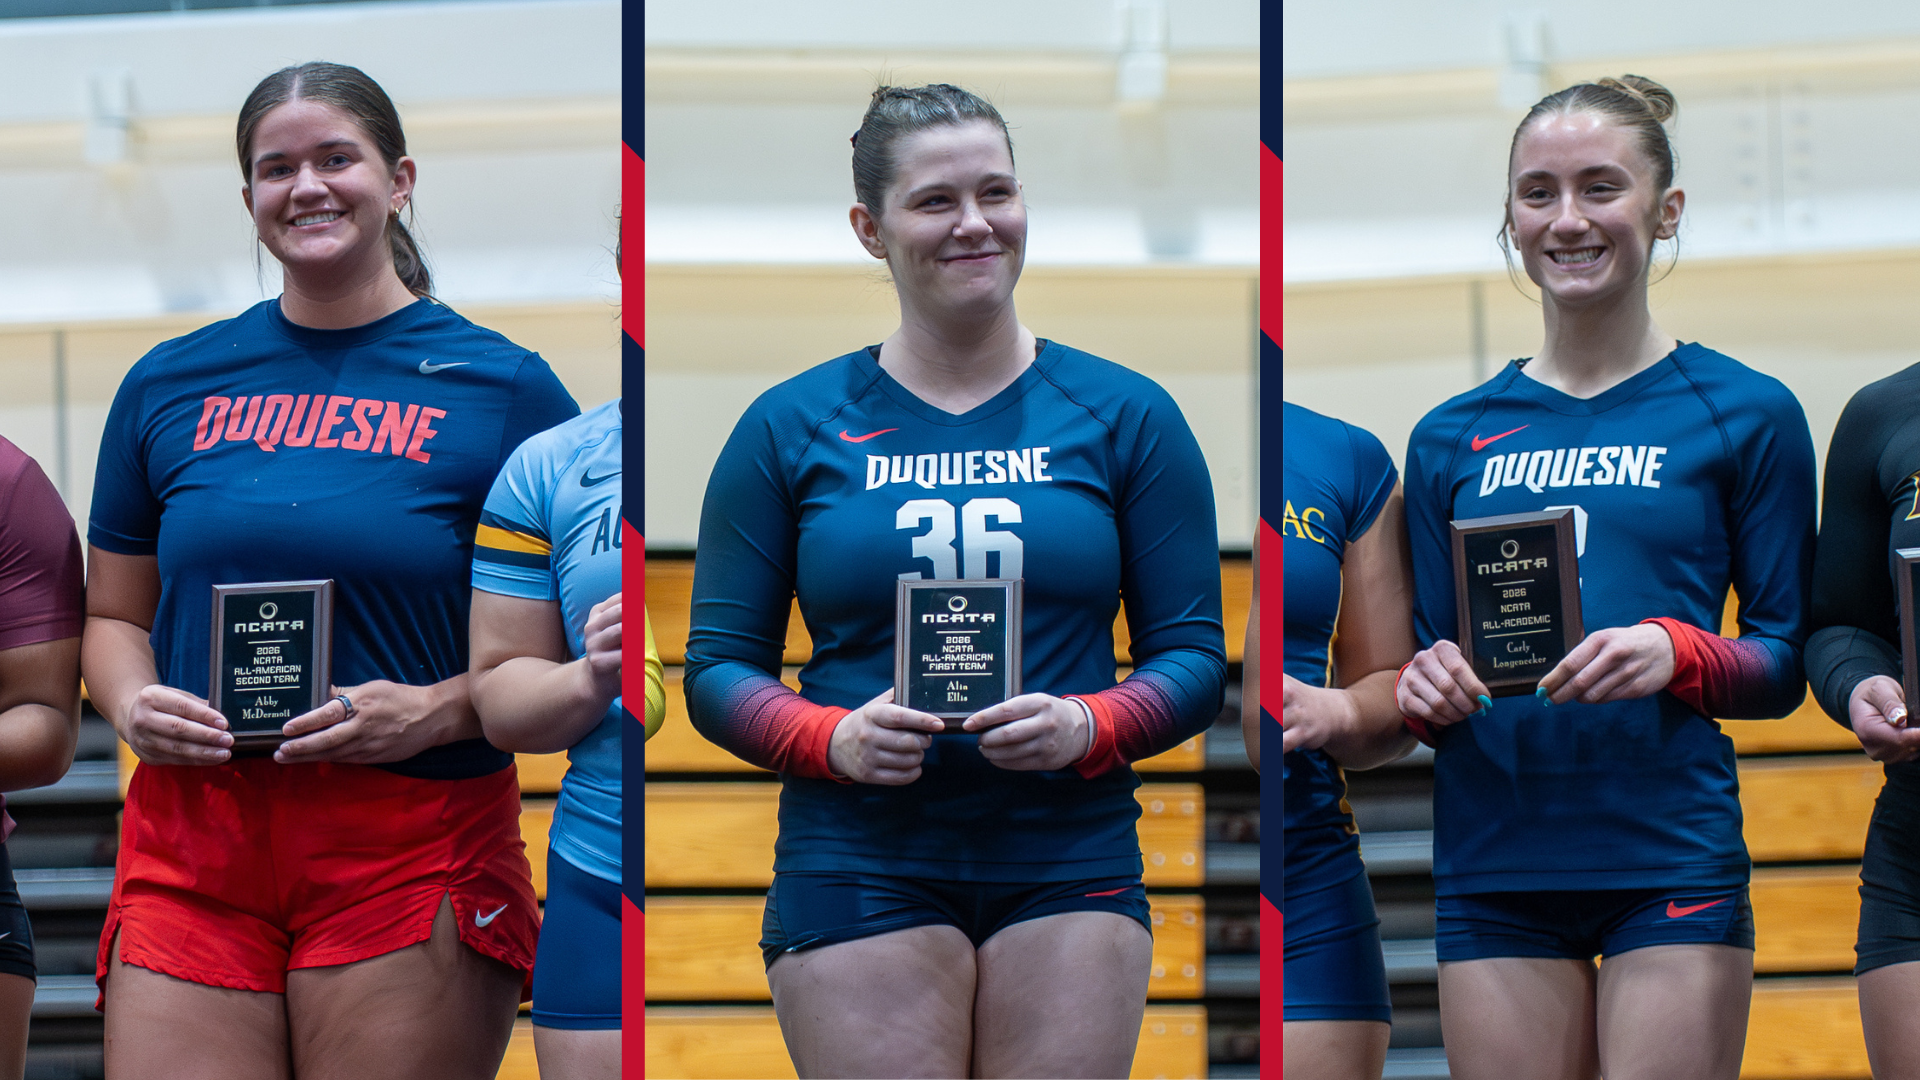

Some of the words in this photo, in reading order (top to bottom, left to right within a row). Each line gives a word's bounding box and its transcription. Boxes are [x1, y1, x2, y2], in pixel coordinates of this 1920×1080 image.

[193, 394, 447, 464] DUQUESNE
[865, 446, 1053, 490] DUQUESNE
[1478, 445, 1668, 497] DUQUESNE
[896, 497, 1023, 580] 36
[1477, 557, 1548, 575] NCATA
[1502, 588, 1527, 598] 2026
[1500, 602, 1531, 613] NCATA
[922, 613, 995, 623] NCATA
[1482, 614, 1551, 630] ALL-ACADEMIC
[234, 620, 304, 633] NCATA
[945, 636, 971, 644] 2026
[256, 646, 281, 655] 2026
[942, 645, 974, 653] NCATA
[1506, 640, 1530, 653] Carly
[253, 656, 283, 665] NCATA
[922, 653, 994, 662] ALL-AMERICAN
[1493, 652, 1546, 668] Longenecker
[234, 665, 302, 676] ALL-AMERICAN
[929, 662, 957, 671] FIRST
[958, 662, 986, 670] TEAM
[236, 675, 271, 685] SECOND
[273, 674, 299, 683] TEAM
[254, 695, 279, 707] Abby
[242, 708, 291, 720] McDermott
